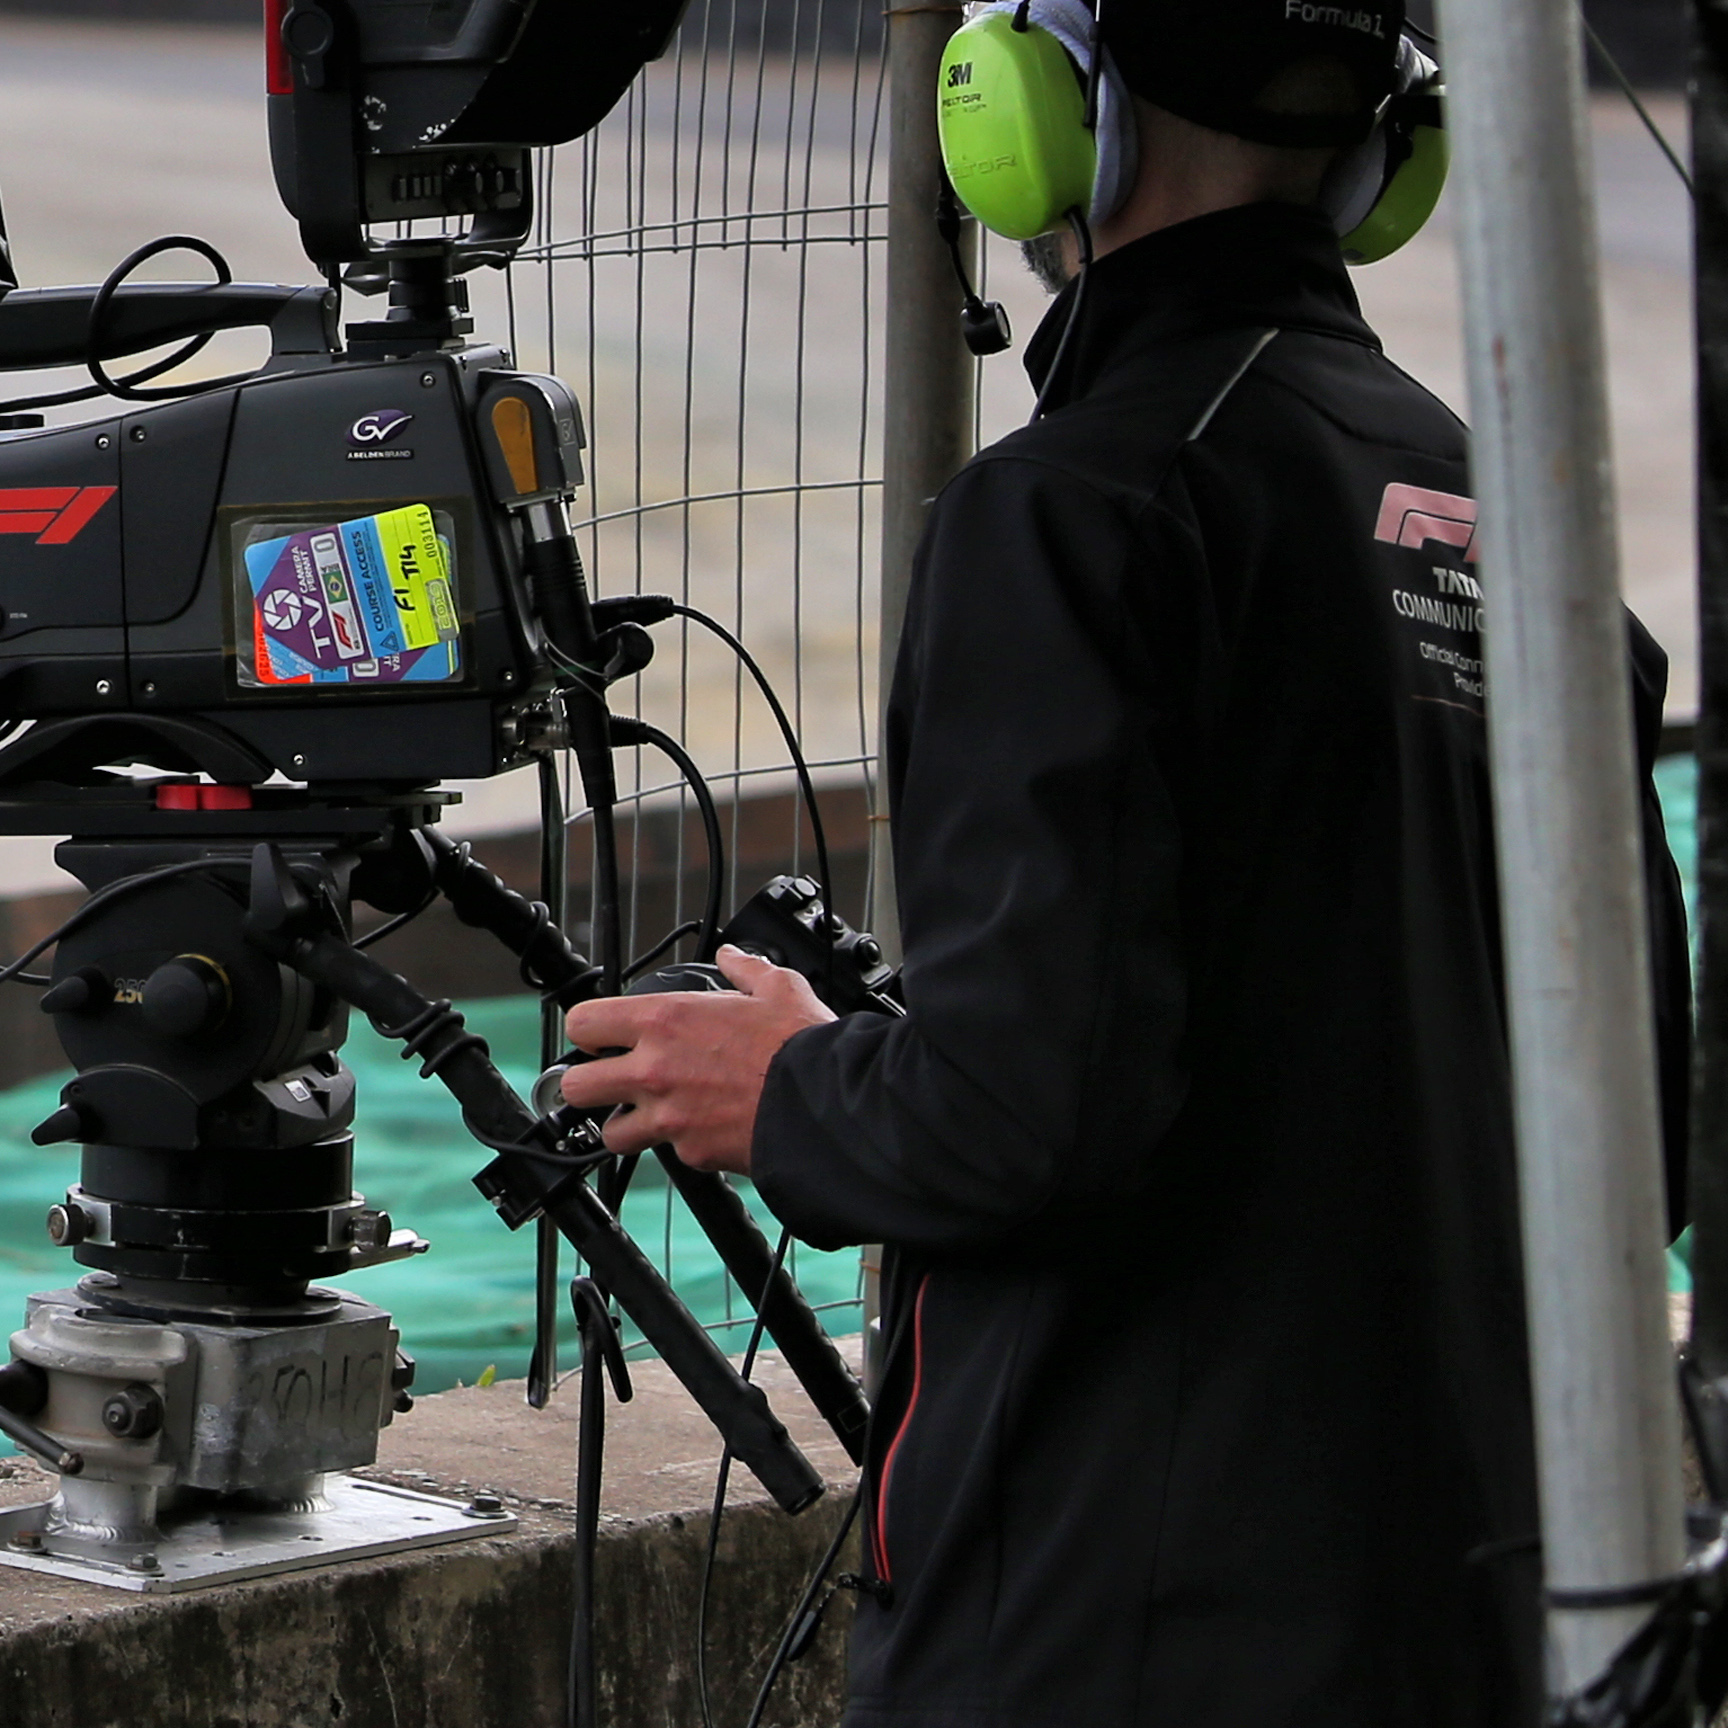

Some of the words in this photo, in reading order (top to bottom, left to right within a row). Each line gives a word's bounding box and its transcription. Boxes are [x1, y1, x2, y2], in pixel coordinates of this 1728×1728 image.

[947, 62, 973, 88] 3M
[352, 415, 413, 441] GV
[417, 511, 437, 558] 003114
[1373, 482, 1481, 563] F
[291, 545, 308, 594] CAMERA
[299, 550, 317, 592] PERMIT
[350, 531, 372, 581] ACCESS
[301, 596, 331, 659] TV
[364, 582, 384, 632] COURSE
[431, 582, 452, 629] 2019
[332, 610, 353, 650] F1
[1419, 641, 1453, 666] Official
